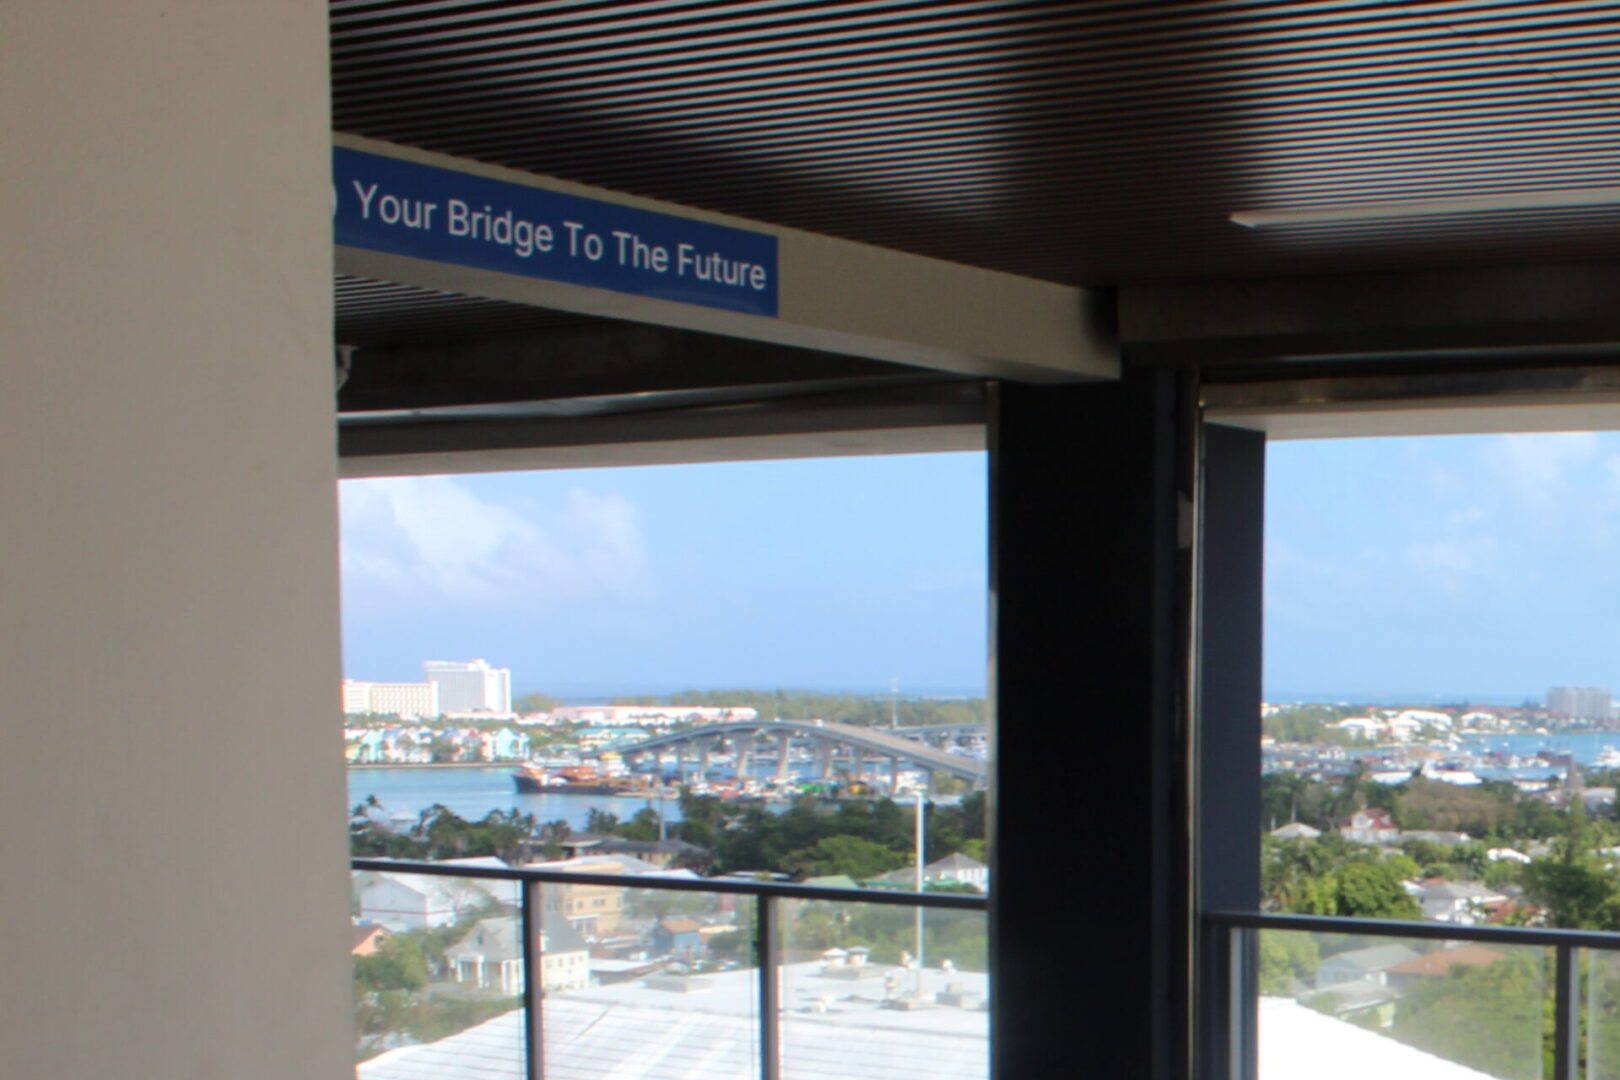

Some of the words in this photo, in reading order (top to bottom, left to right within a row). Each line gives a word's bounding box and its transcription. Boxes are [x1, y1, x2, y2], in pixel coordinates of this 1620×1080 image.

[353, 180, 437, 230] Your
[448, 199, 553, 257] Bridge
[564, 221, 602, 261] To
[612, 231, 669, 273] The
[678, 244, 767, 290] Future
